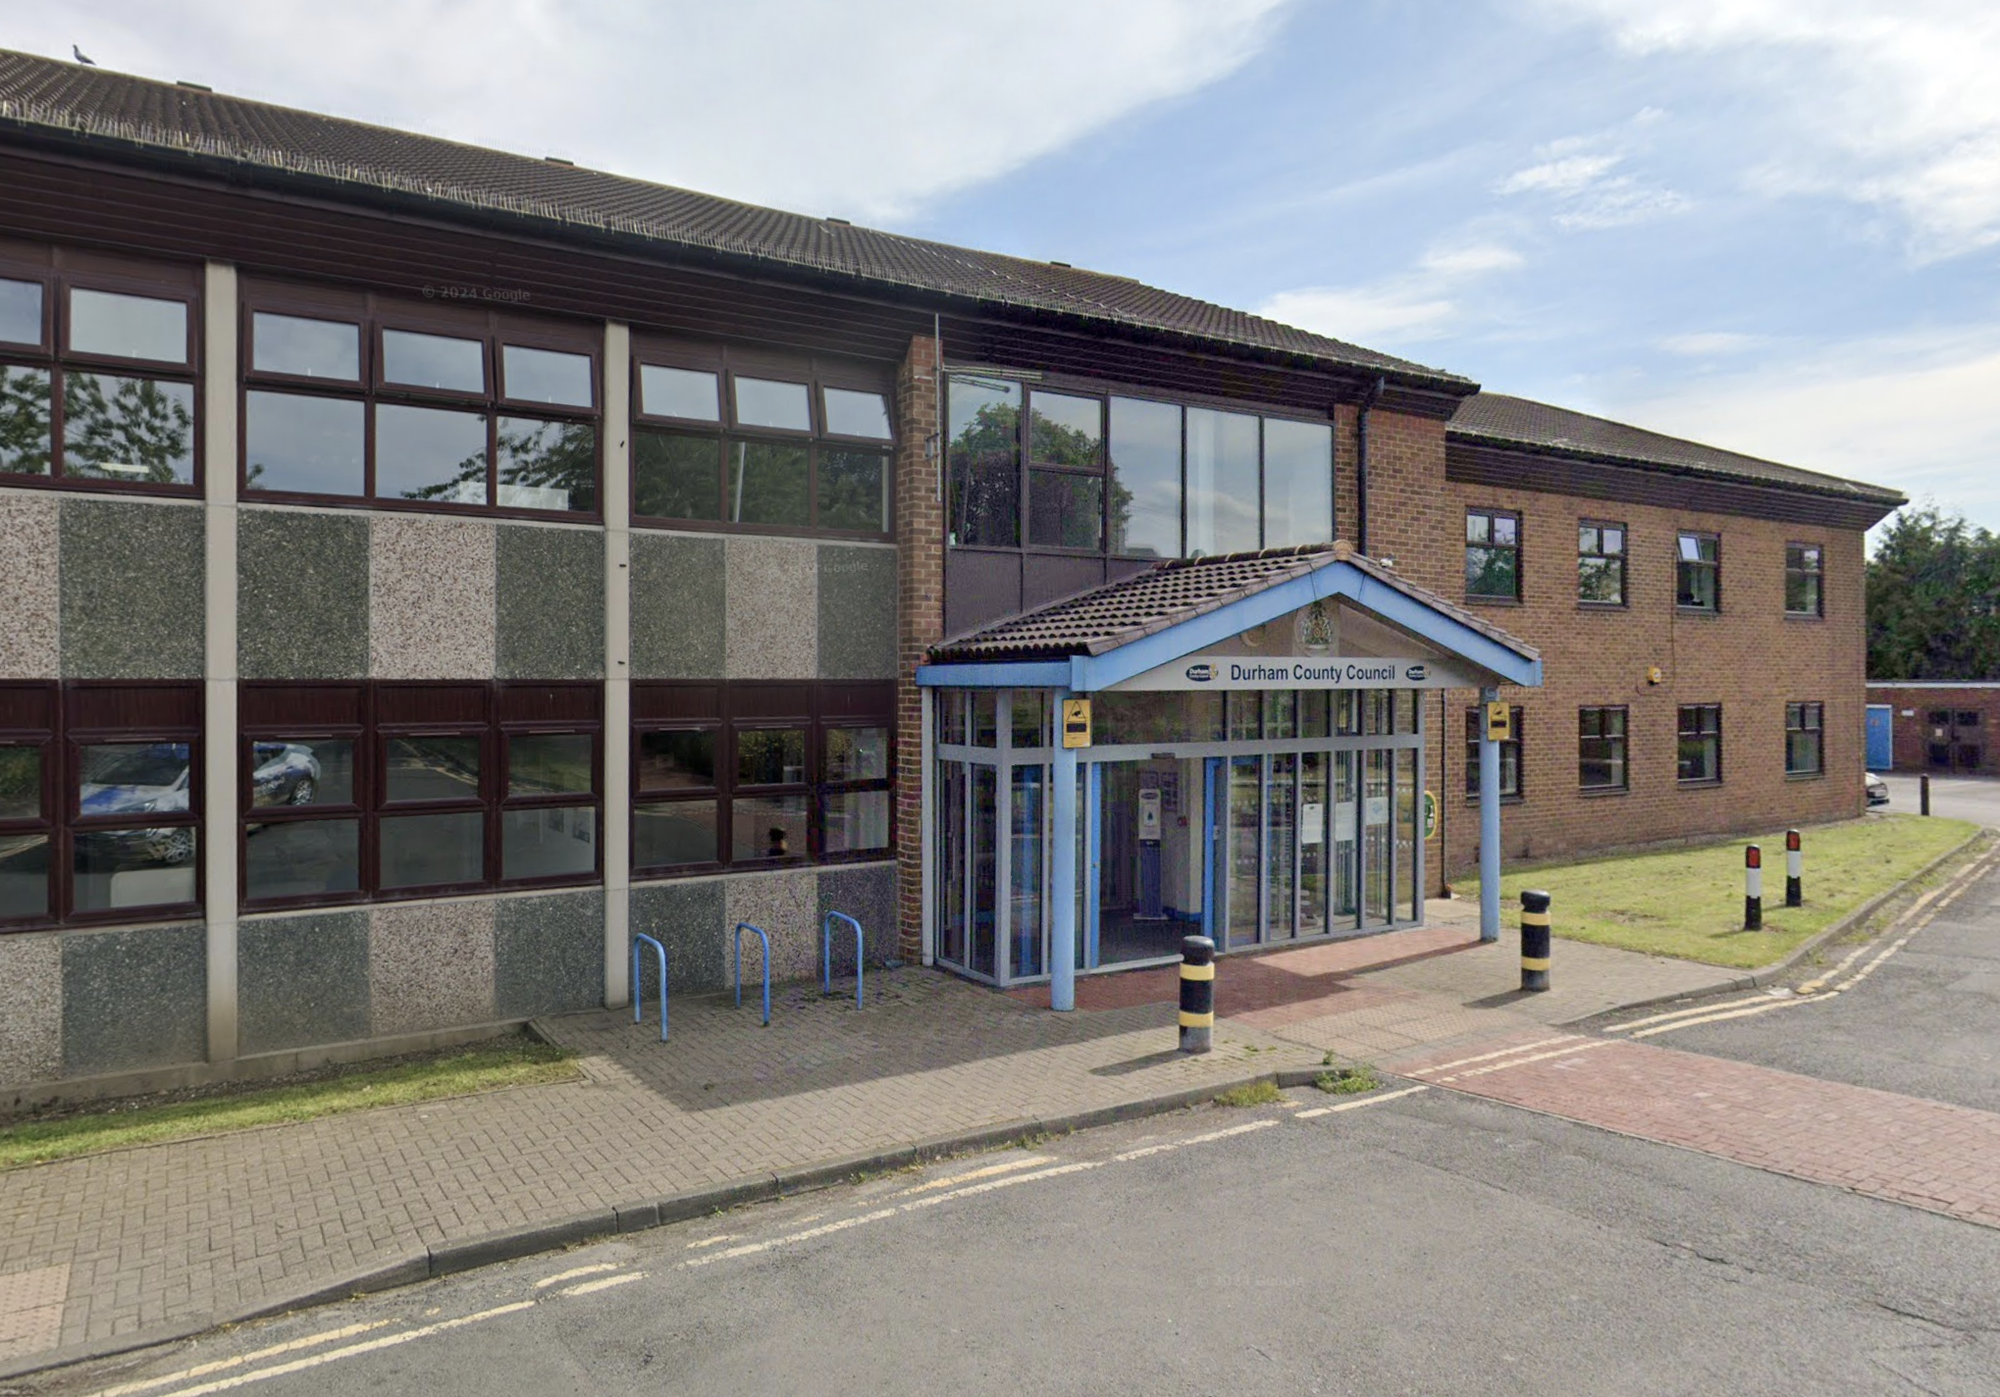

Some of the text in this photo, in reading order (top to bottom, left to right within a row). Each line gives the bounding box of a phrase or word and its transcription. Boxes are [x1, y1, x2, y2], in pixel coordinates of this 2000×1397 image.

[1231, 664, 1396, 684] Durham County Council
